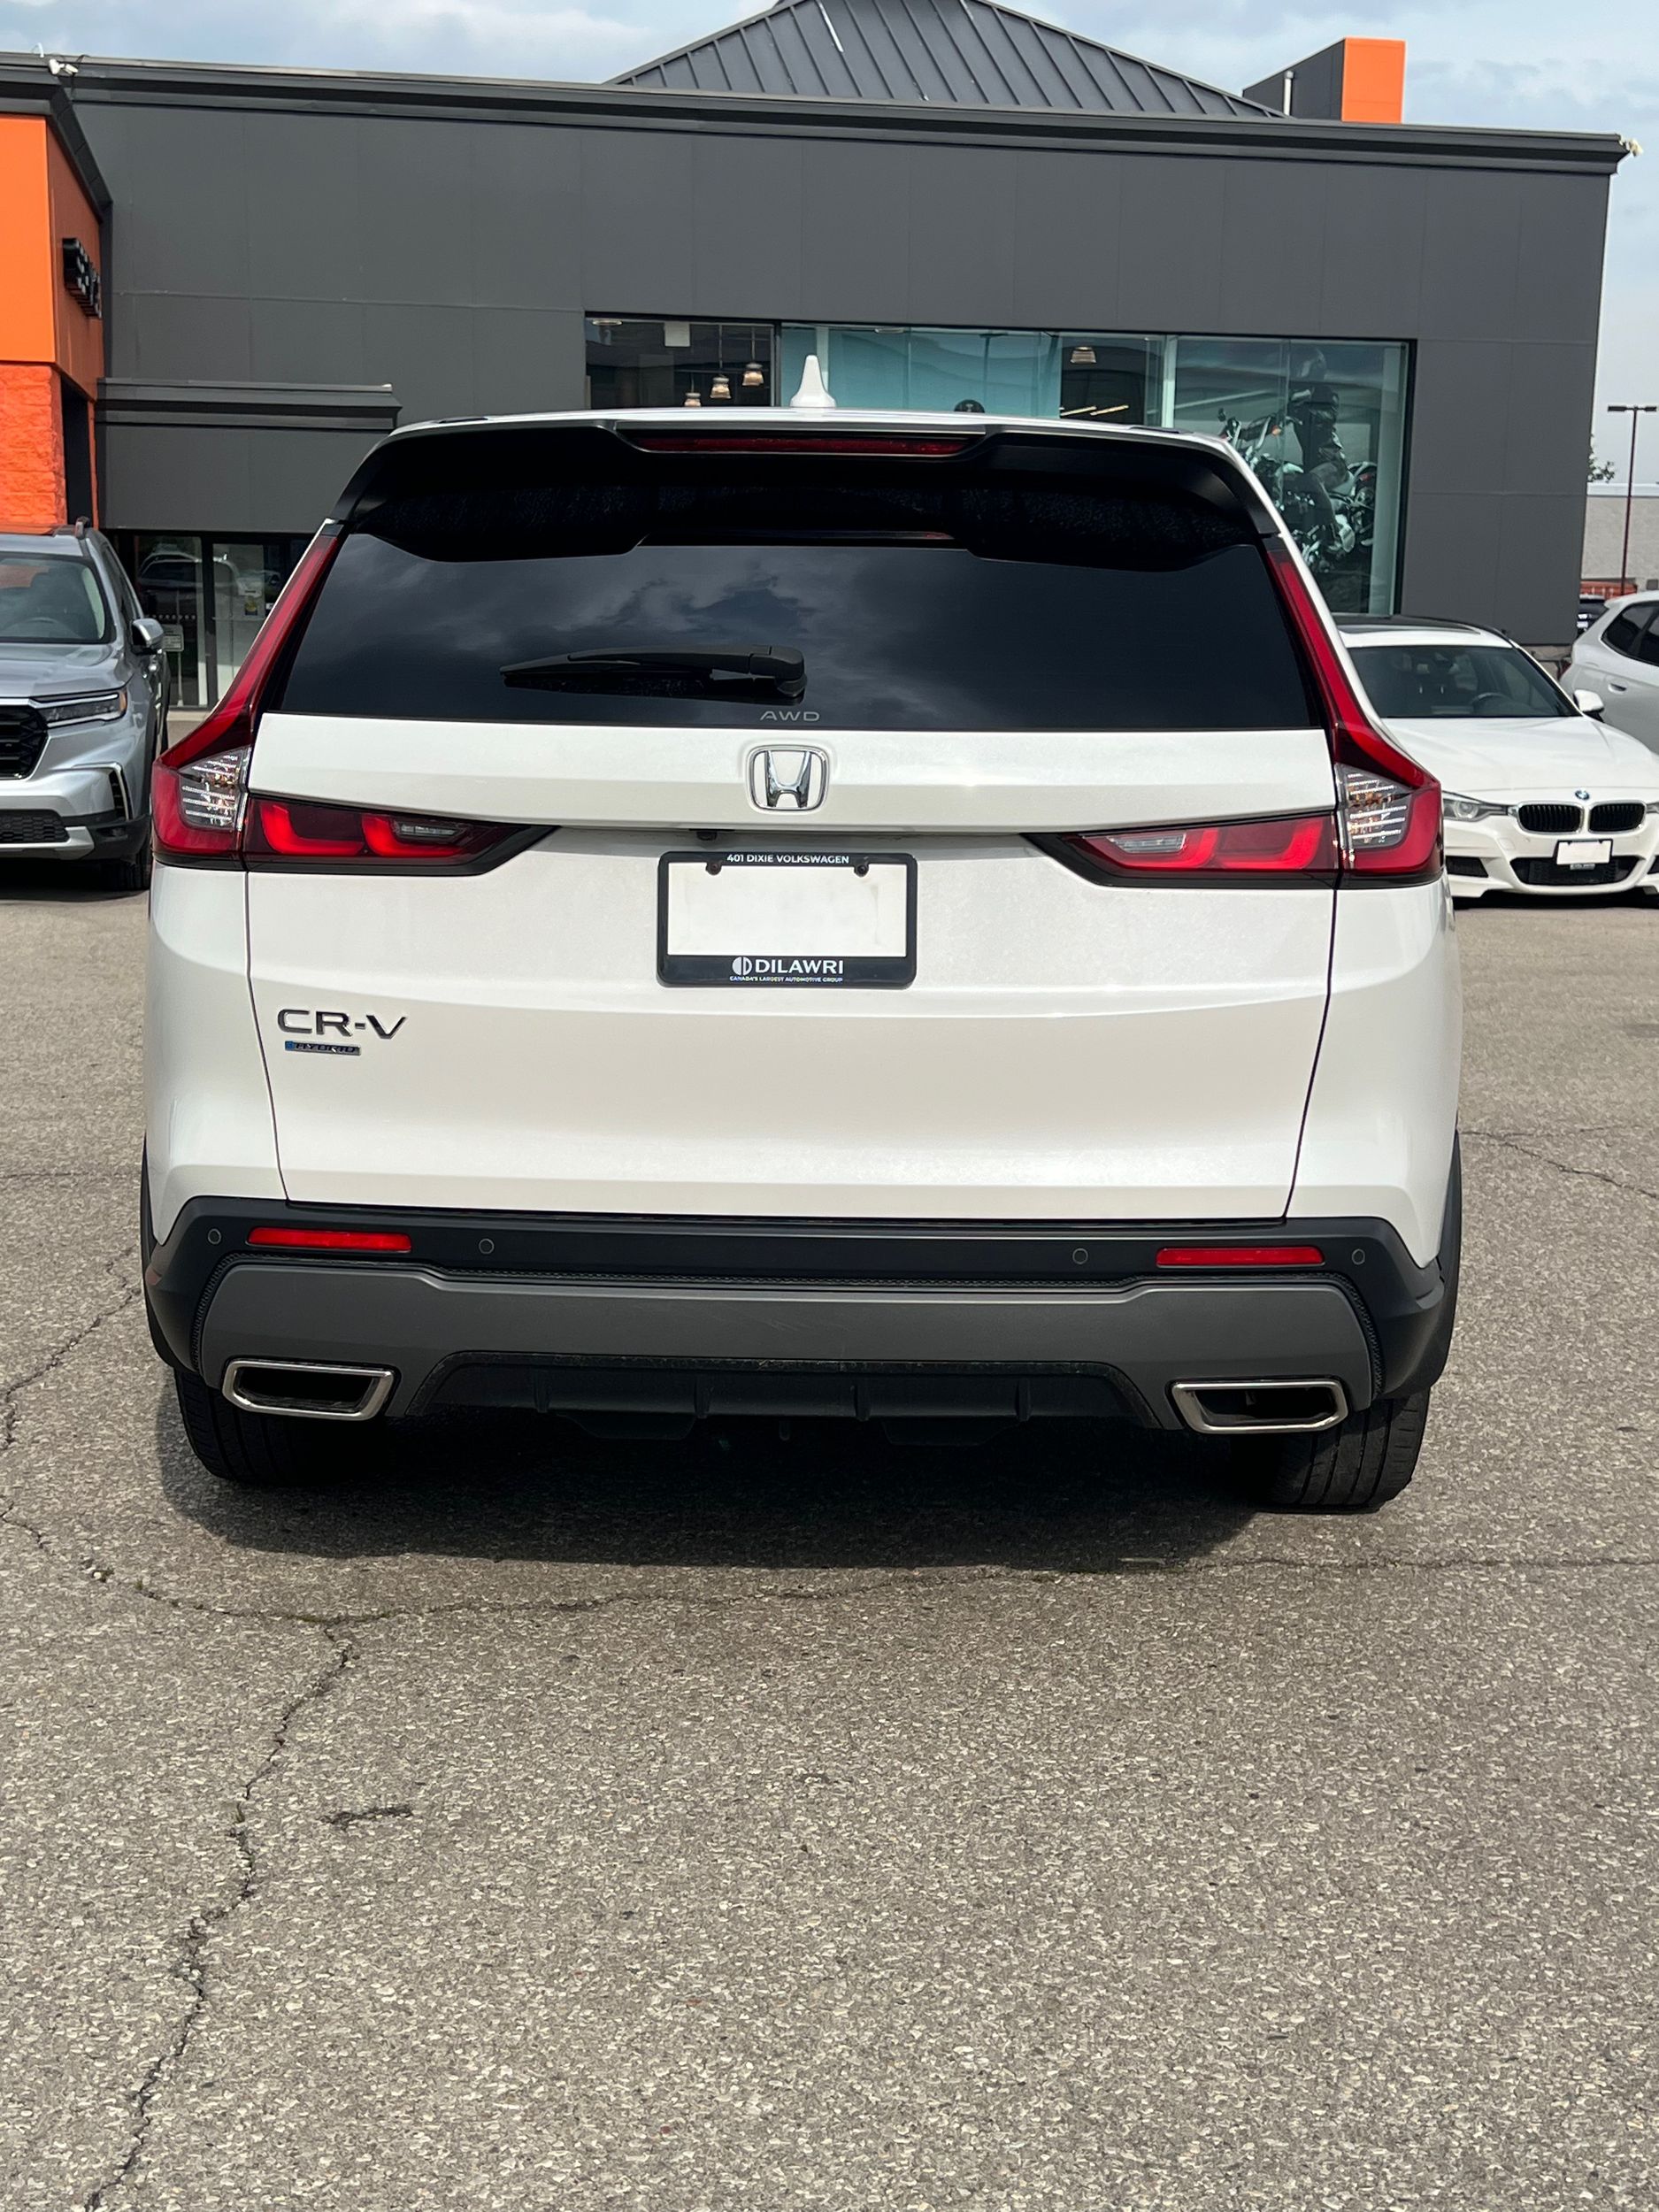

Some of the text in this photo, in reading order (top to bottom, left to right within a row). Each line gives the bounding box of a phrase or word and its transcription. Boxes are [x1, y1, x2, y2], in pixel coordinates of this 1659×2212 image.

[760, 710, 819, 721] AWD
[726, 854, 849, 864] 401 DIXIE VOLKSWAGEN
[755, 959, 843, 974] DILAWRI
[277, 1009, 407, 1040] CR-V
